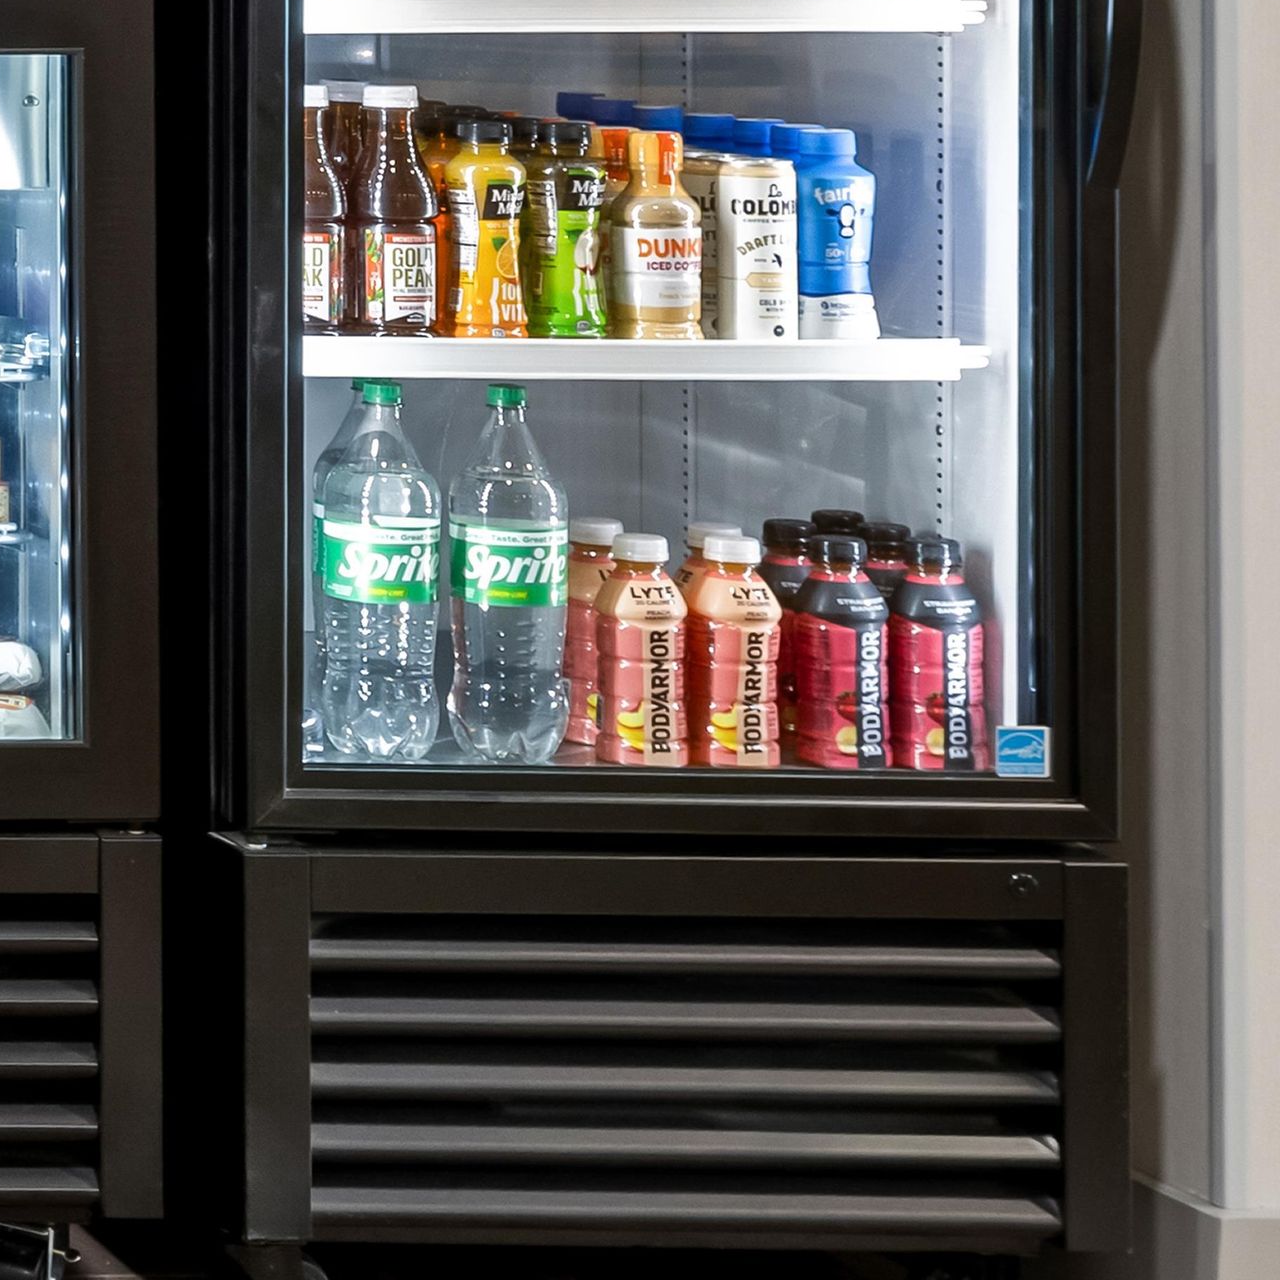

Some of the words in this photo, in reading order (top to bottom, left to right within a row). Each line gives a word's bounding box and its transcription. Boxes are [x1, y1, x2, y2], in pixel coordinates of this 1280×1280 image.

[392, 268, 433, 287] PEAK
[647, 262, 672, 271] ICED
[738, 234, 777, 256] DRAFT
[630, 586, 674, 600] LYTE
[651, 630, 671, 754] BODYARMOR
[744, 631, 765, 755] BODYARMOR
[861, 631, 882, 756] BODYARMOR
[945, 632, 967, 760] BODYARMOR
